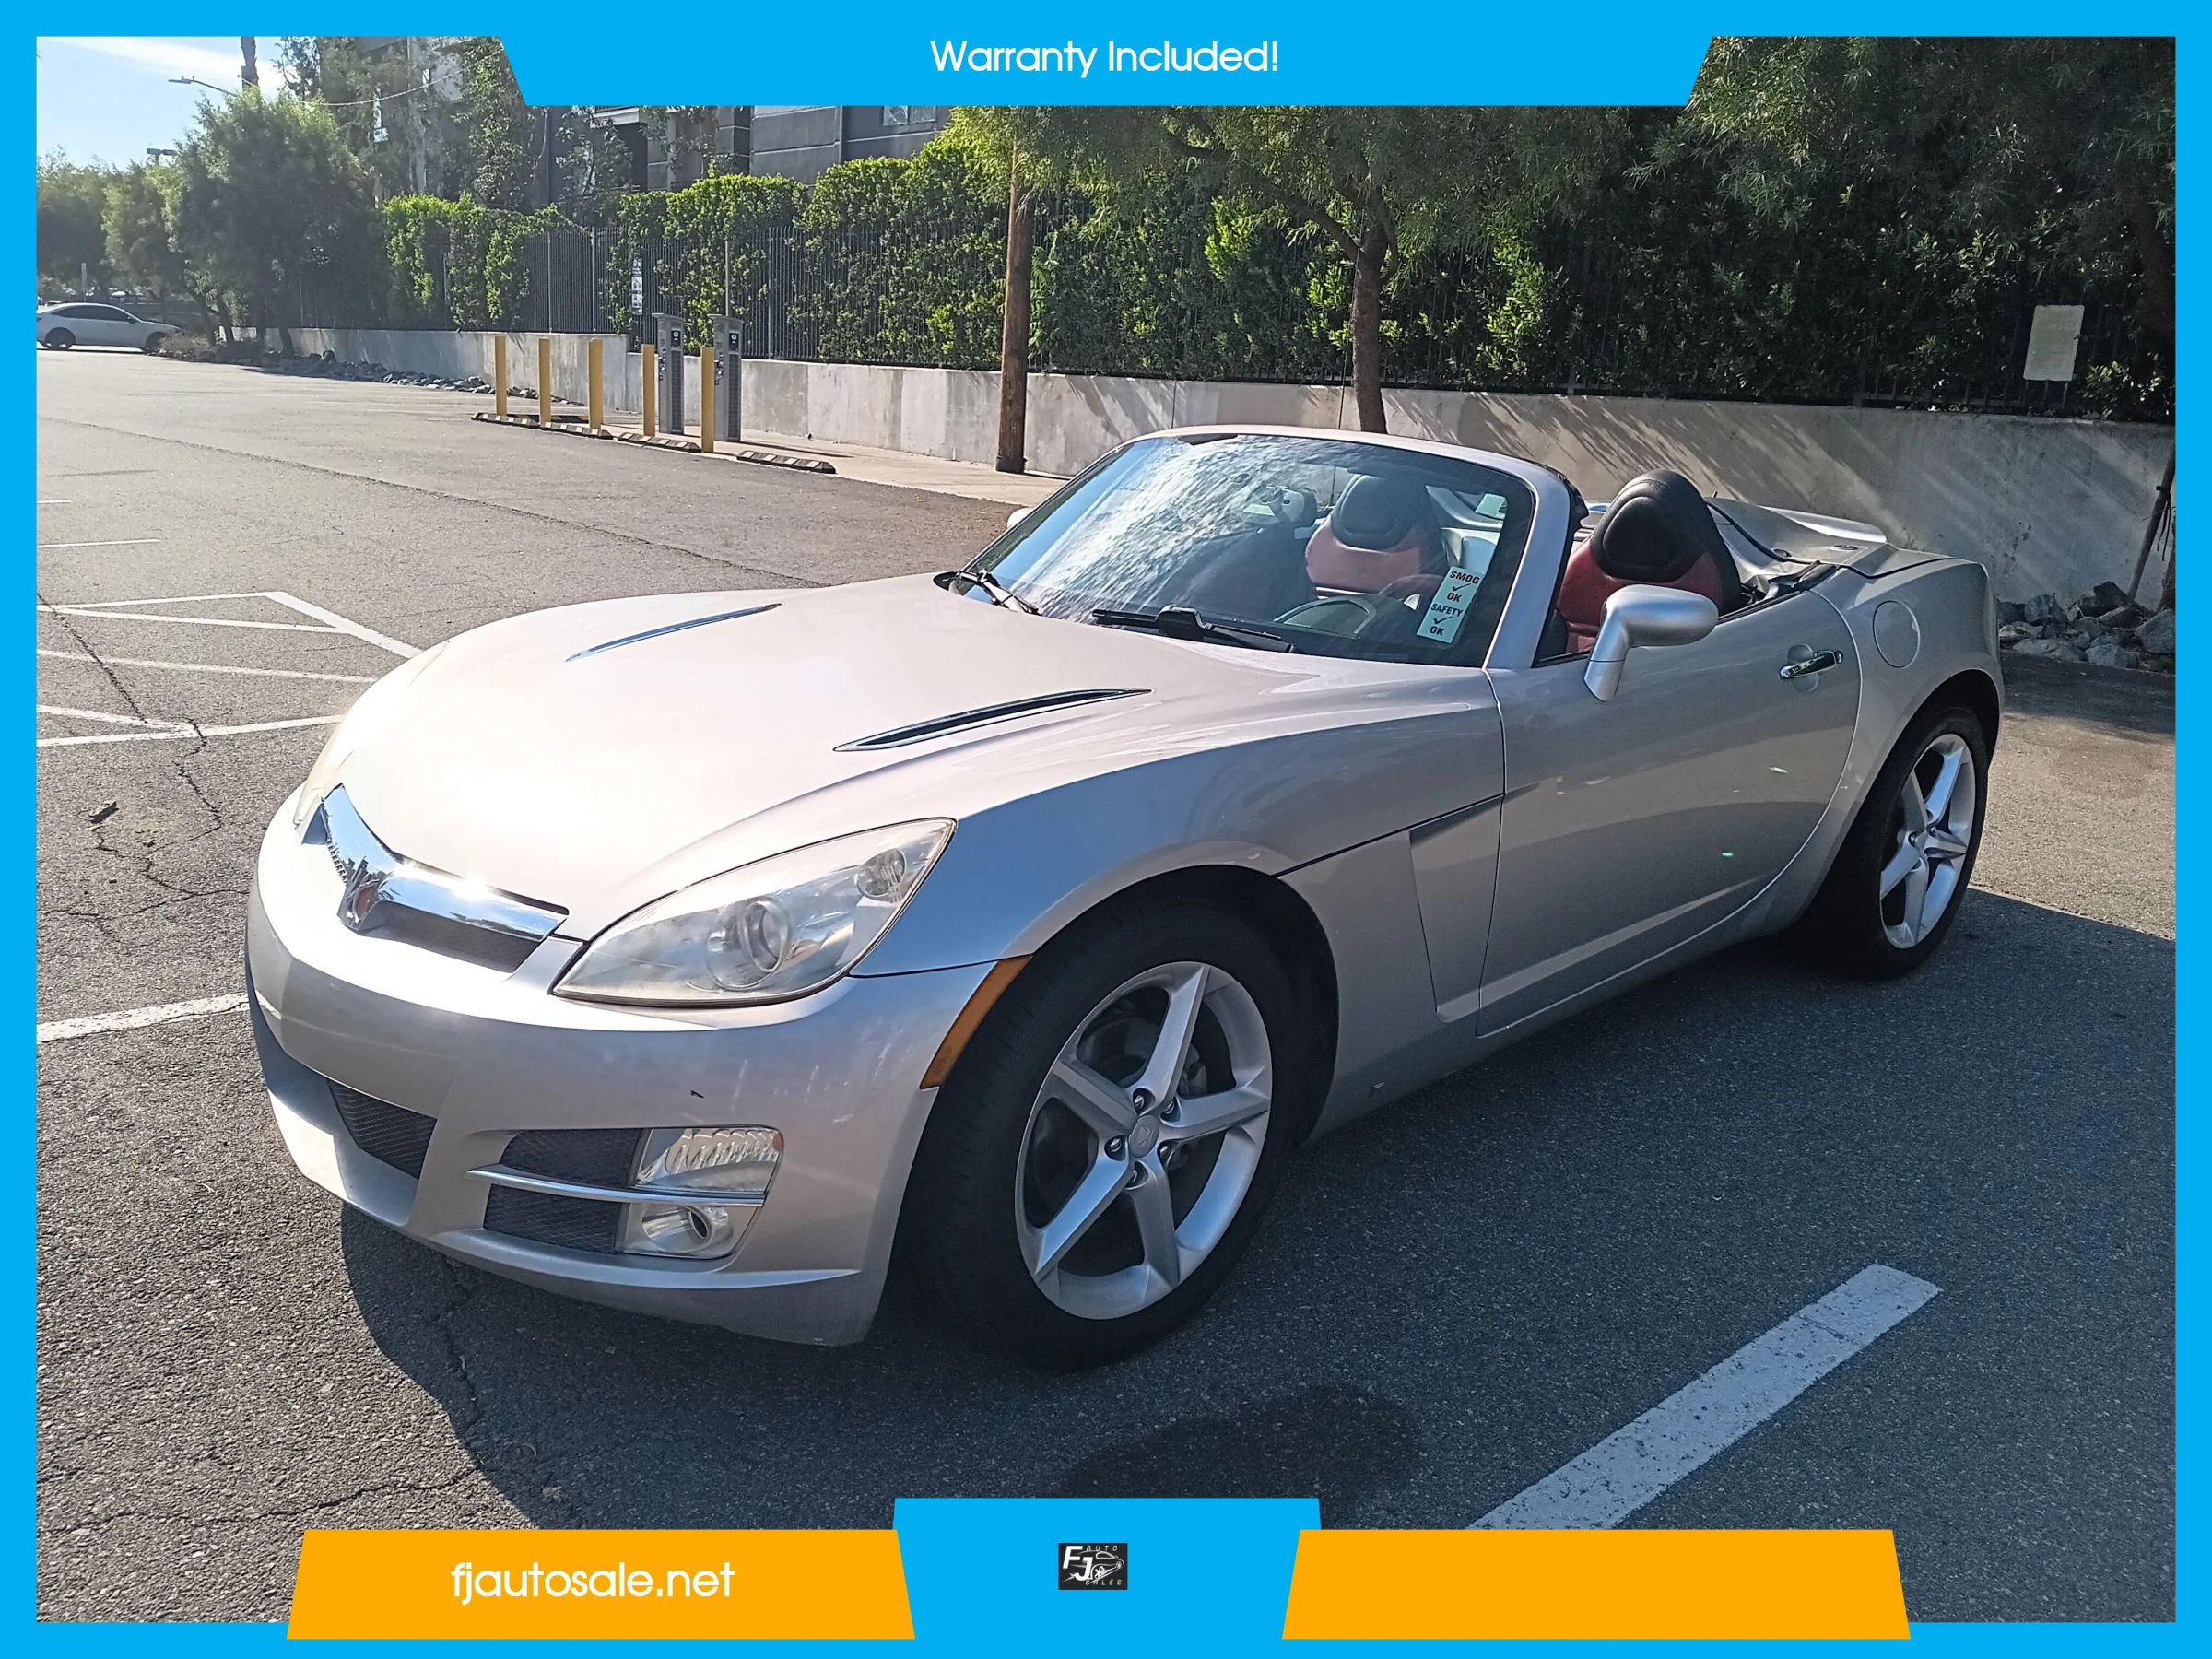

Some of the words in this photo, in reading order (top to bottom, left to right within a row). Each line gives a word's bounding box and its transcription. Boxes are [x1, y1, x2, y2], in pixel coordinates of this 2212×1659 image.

[1449, 571, 1480, 584] SMOG
[1446, 592, 1463, 602] OK
[1430, 603, 1464, 617] SAFETY
[1430, 625, 1445, 636] OK
